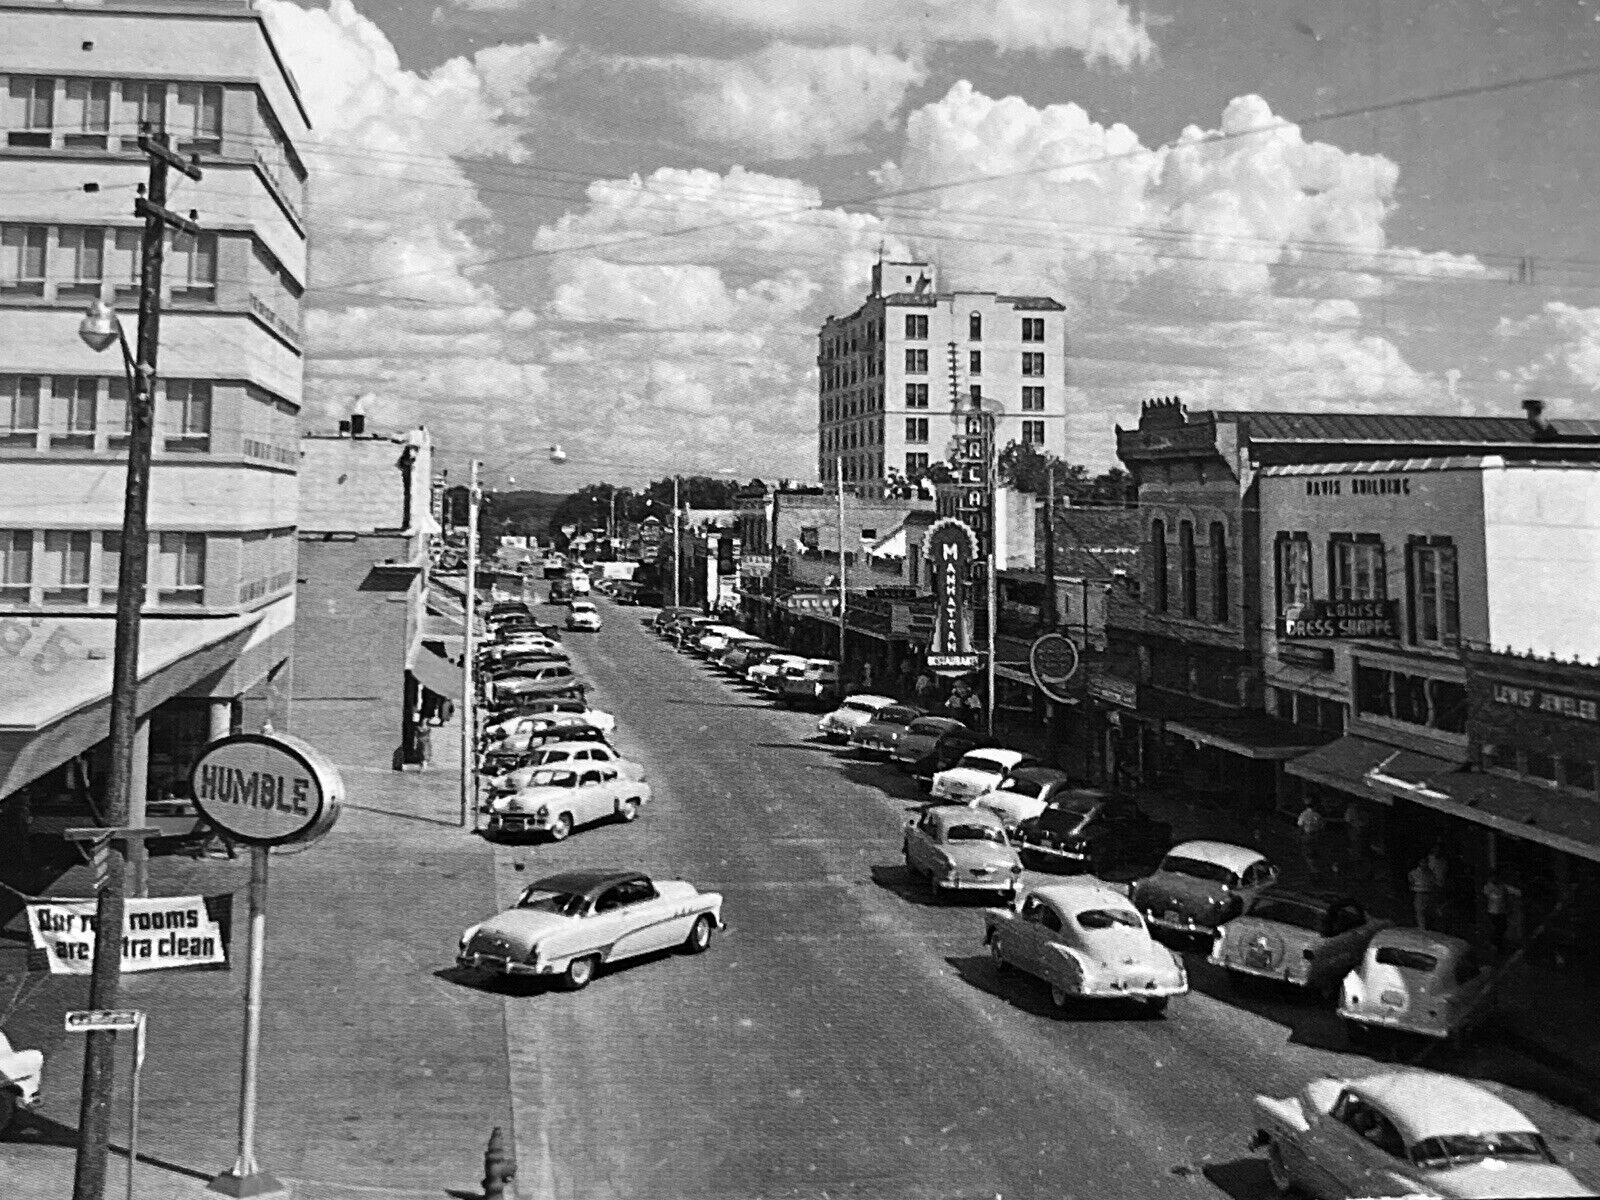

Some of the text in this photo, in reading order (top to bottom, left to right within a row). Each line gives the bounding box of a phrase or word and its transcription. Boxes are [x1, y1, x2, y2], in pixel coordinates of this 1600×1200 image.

[1352, 479, 1410, 495] BUILDING
[942, 543, 958, 652] MANHATTAN
[1286, 620, 1334, 636] DRESS
[201, 764, 309, 816] HUMBLE
[38, 908, 77, 932] Our
[129, 909, 199, 931] rooms
[56, 931, 215, 960] are tra clean
